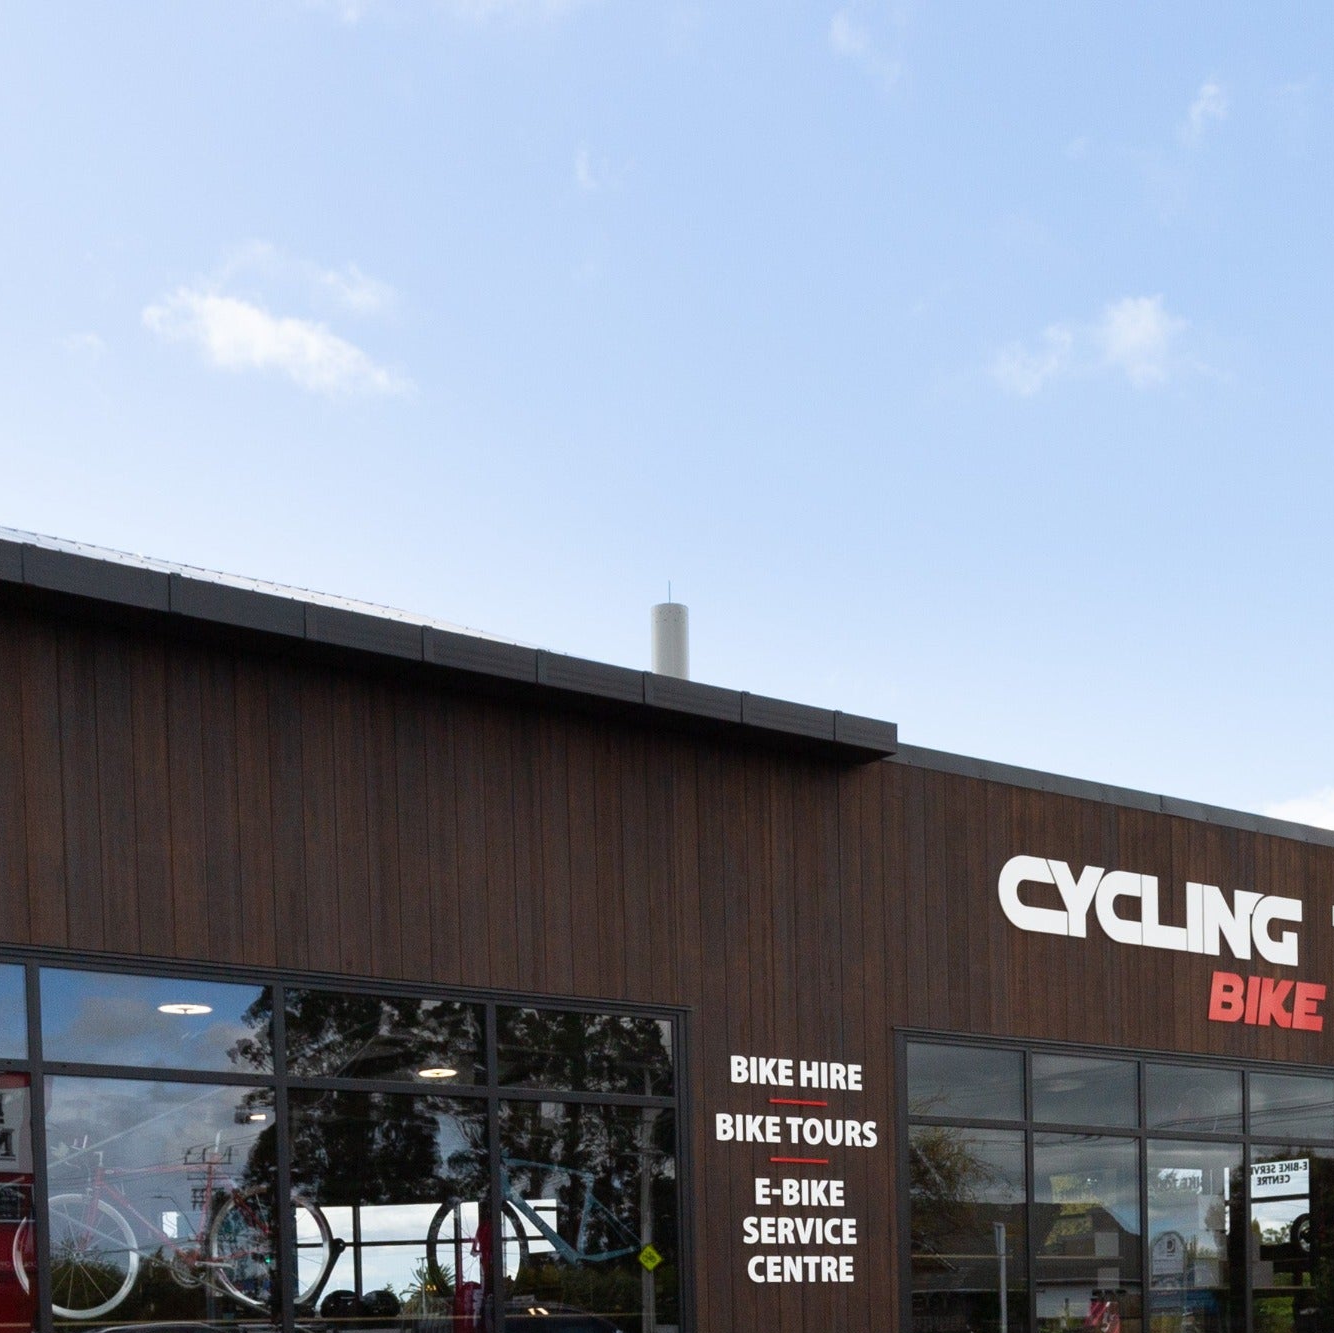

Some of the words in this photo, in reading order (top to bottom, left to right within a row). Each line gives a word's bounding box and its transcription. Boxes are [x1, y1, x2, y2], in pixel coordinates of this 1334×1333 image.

[998, 855, 1302, 966] CYCLING
[1208, 971, 1326, 1032] BIKE
[730, 1055, 794, 1086] BIKE
[799, 1060, 863, 1091] HIRE
[716, 1113, 781, 1143] BIKE
[786, 1116, 878, 1148] TOURS
[755, 1178, 845, 1207] E-BIKE
[742, 1216, 857, 1245] SERVICE
[747, 1256, 855, 1283] CENTRE
